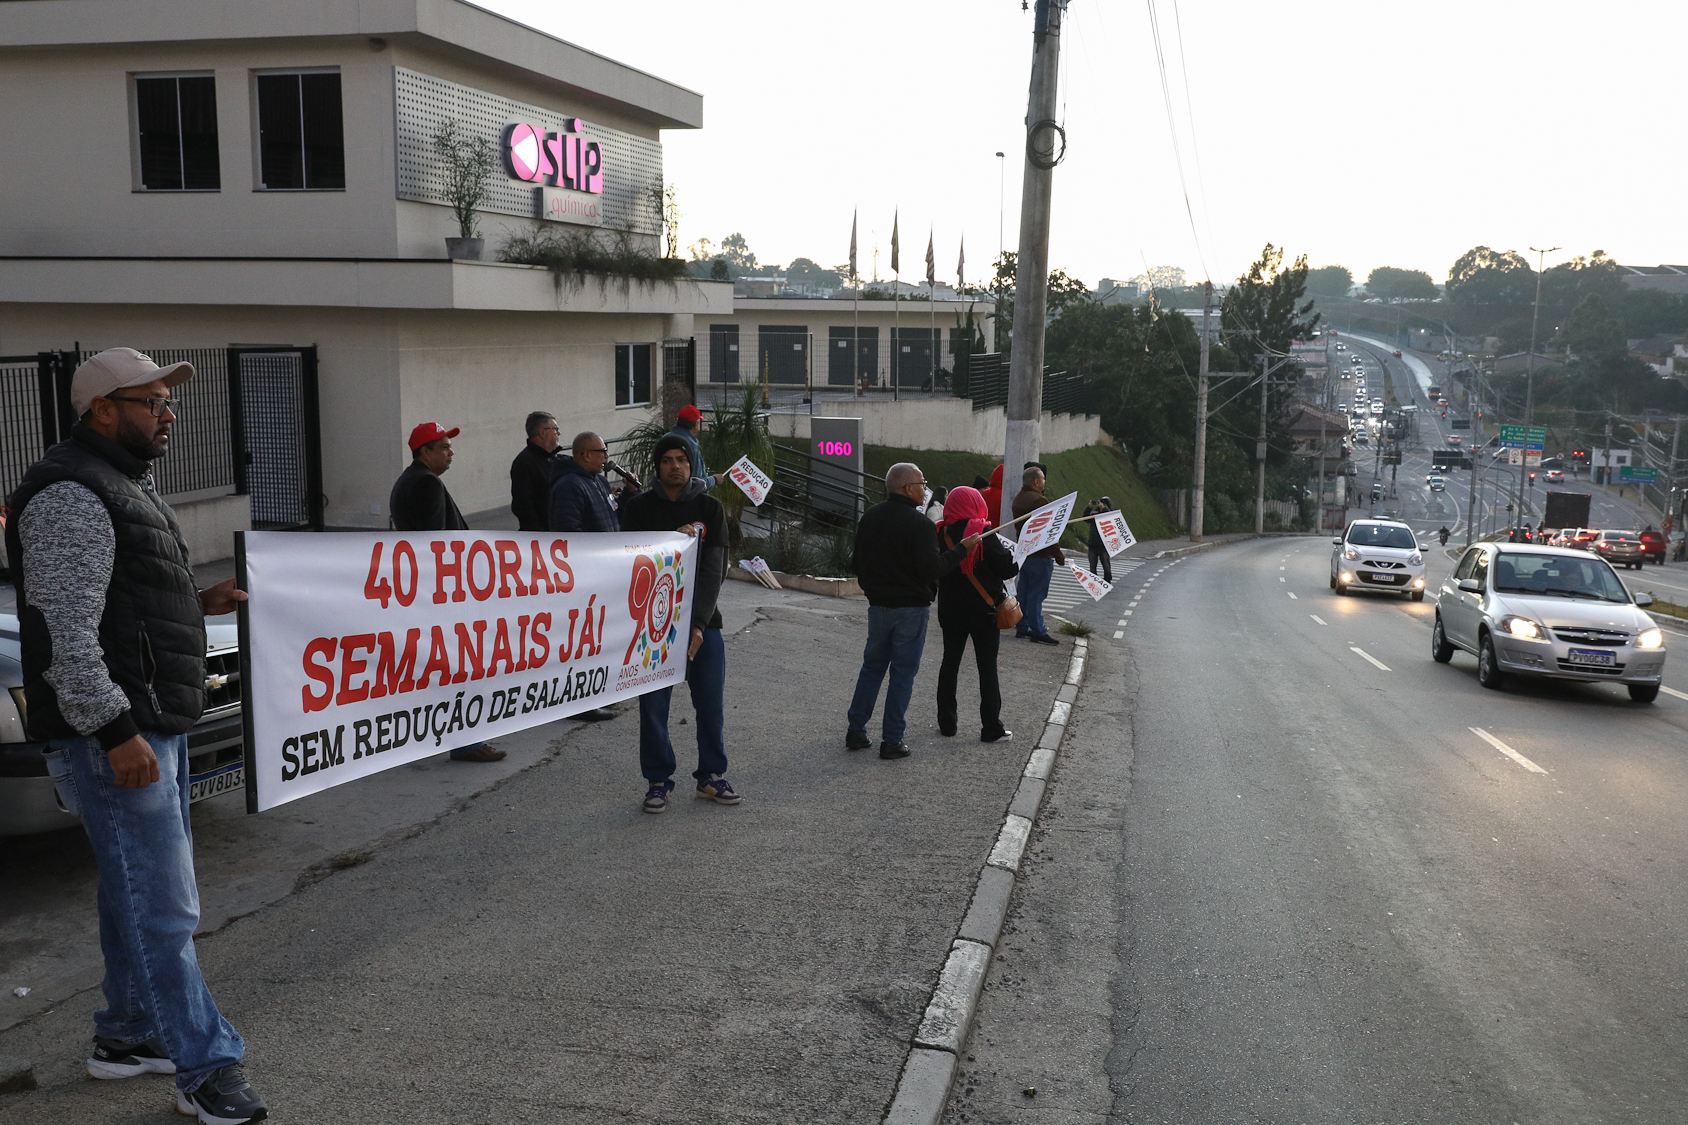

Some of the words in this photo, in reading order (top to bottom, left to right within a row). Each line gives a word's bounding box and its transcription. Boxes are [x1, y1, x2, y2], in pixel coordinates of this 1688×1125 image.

[552, 194, 597, 218] química
[818, 441, 852, 456] 1060
[740, 461, 769, 489] REDUÇÃO
[1099, 520, 1116, 537] JÁ!
[364, 540, 418, 609] 40
[430, 539, 575, 604] HORAS
[302, 612, 552, 714] SEMANAIS
[559, 594, 606, 664] JÁ!
[615, 674, 651, 692] CONSTRUINDO
[656, 667, 675, 680] FUTURO
[618, 664, 639, 680] ANOS
[281, 724, 345, 782] SEM
[353, 690, 484, 761] REDUÇÃO
[487, 685, 521, 723] DE
[522, 665, 609, 715] SALÁRIO!
[190, 769, 245, 800] CVV8D3
